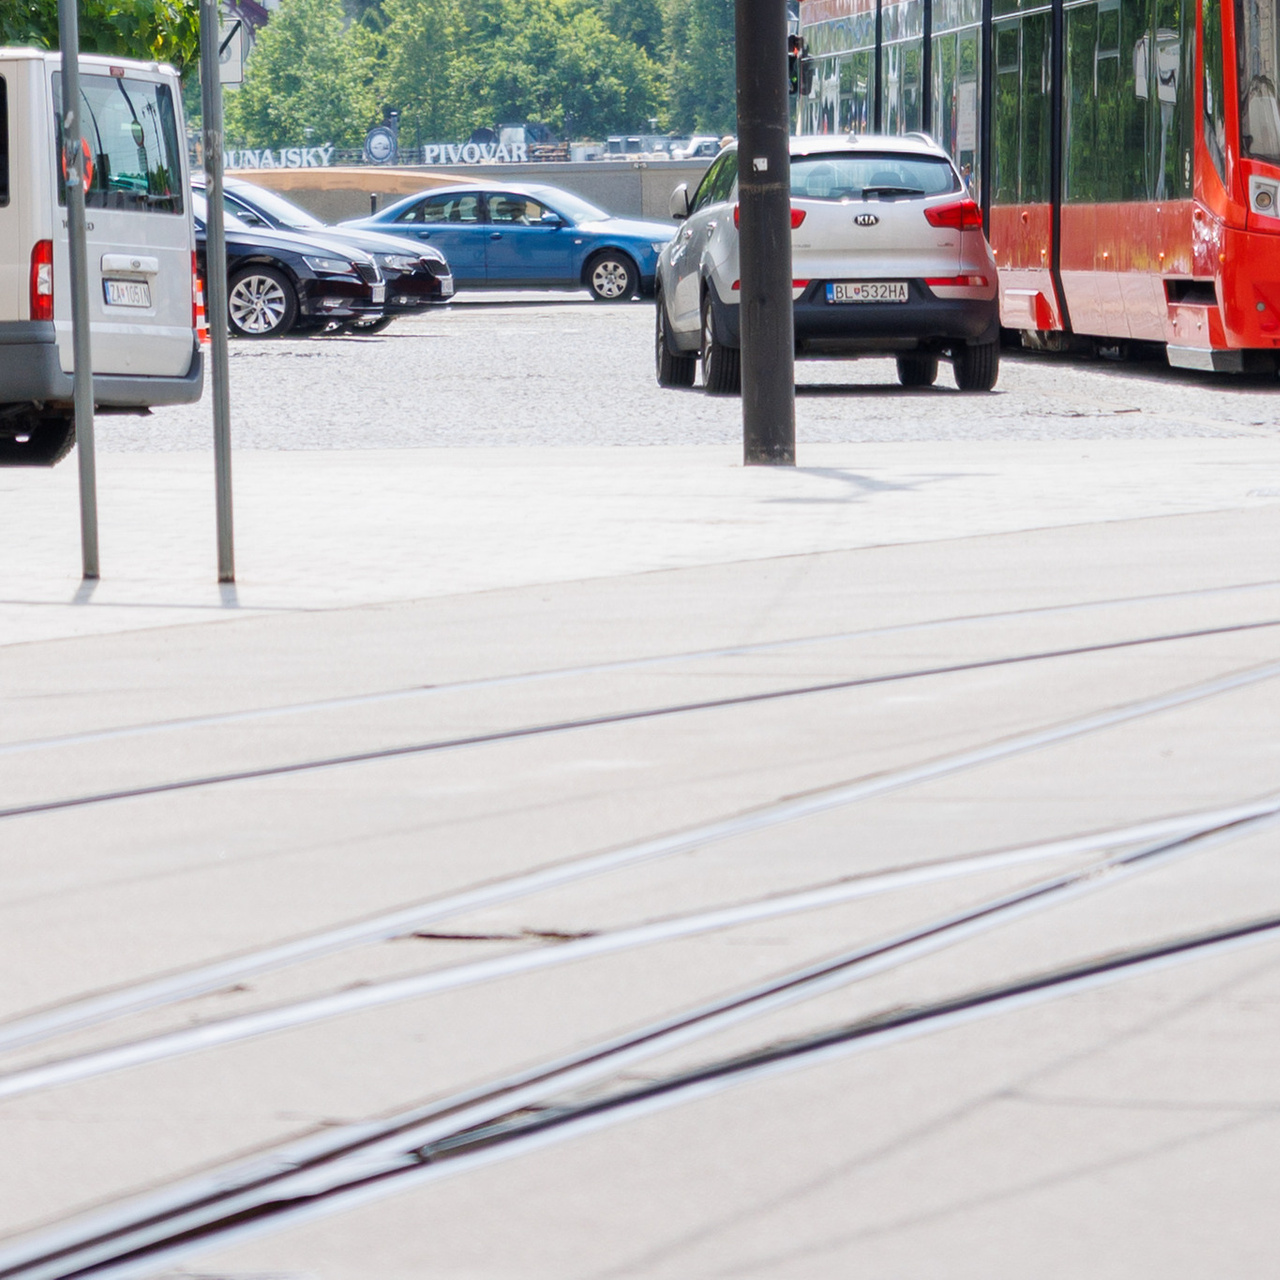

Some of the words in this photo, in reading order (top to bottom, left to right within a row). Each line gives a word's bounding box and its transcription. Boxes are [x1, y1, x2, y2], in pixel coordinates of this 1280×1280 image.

[424, 142, 528, 164] PIVOVAR
[857, 215, 876, 225] KIA
[835, 285, 853, 299] BL
[861, 284, 906, 299] 532HA
